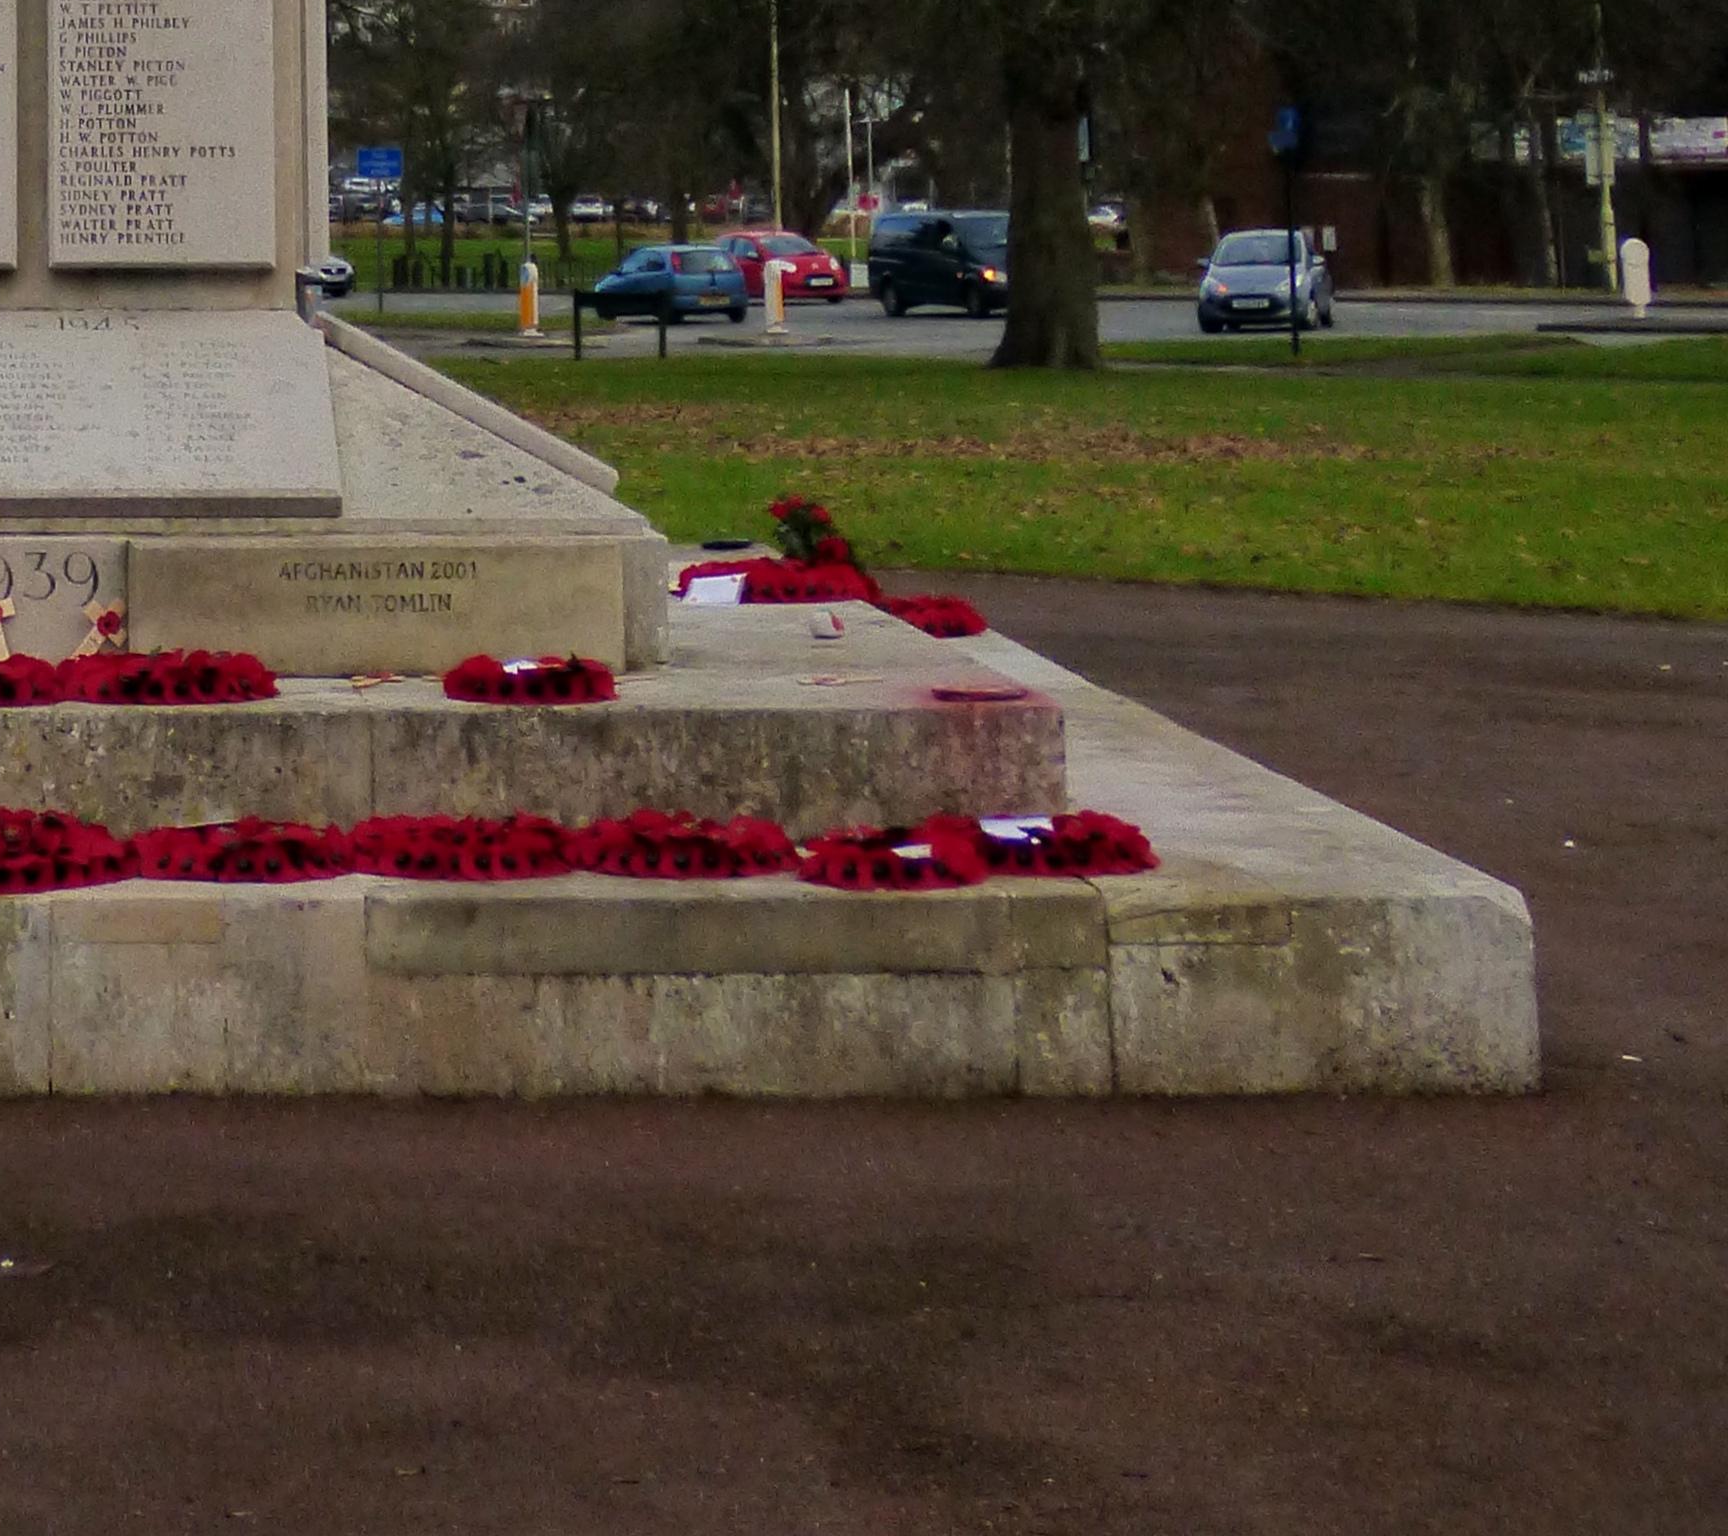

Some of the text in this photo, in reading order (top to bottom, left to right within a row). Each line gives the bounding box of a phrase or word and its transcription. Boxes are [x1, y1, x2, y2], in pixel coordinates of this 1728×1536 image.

[99, 3, 158, 15] PETTITT
[58, 18, 105, 29] JAMES
[77, 32, 136, 44] PHILLIPS
[75, 46, 127, 57] PICTON
[59, 61, 185, 72] STANLEY PICTON
[60, 75, 114, 87] WALTER
[81, 89, 142, 100] PIGGOTT
[98, 104, 163, 114] PLUMMER
[78, 118, 136, 129] POTTON
[100, 132, 158, 143] POTTON
[59, 146, 235, 158] CHARLES HENRY POTTS
[75, 162, 136, 173] POULTER
[60, 175, 187, 186] REGINALD PRATT
[59, 190, 165, 201] SIDNEY PRATT
[59, 204, 172, 215] SYDNEY PRATT
[60, 220, 173, 230] WALTER PRATT
[60, 233, 183, 244] HENRY PRENTICE
[60, 316, 139, 332] 1945
[279, 561, 477, 581] AFGHANISTAN 2001
[306, 594, 452, 614] RYAN TOMLIN
